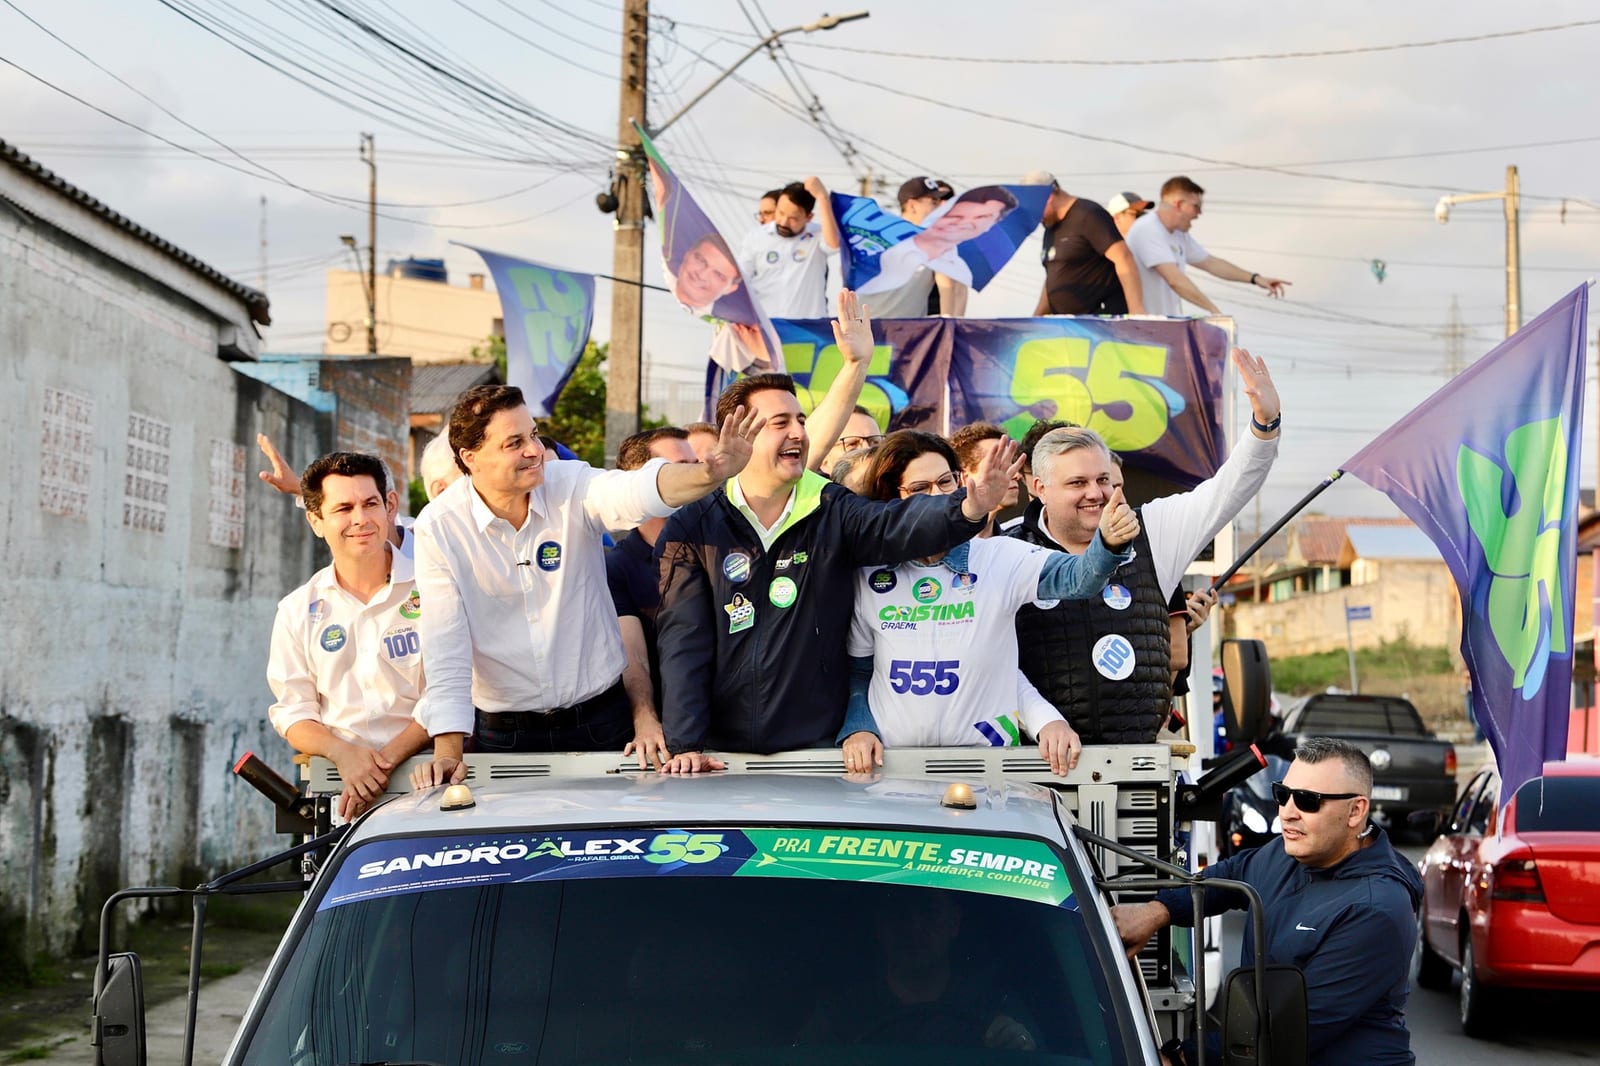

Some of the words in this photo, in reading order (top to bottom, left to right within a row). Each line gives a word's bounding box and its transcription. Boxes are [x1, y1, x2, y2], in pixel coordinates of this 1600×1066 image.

[1002, 337, 1168, 451] 55
[879, 600, 975, 622] CRISTINA
[881, 621, 918, 631] GRAEML
[383, 631, 420, 659] 100
[1098, 638, 1131, 675] 100
[889, 659, 960, 696] 555
[357, 844, 528, 880] SANDRO
[524, 839, 647, 860] ALEX
[642, 834, 725, 864] 55
[610, 854, 641, 862] GRECA
[772, 838, 811, 853] PRA
[817, 835, 943, 864] FRENTE,
[948, 848, 1058, 880] SEMPRE
[902, 861, 913, 870] A
[916, 862, 984, 879] mudança
[987, 872, 1051, 889] continua
